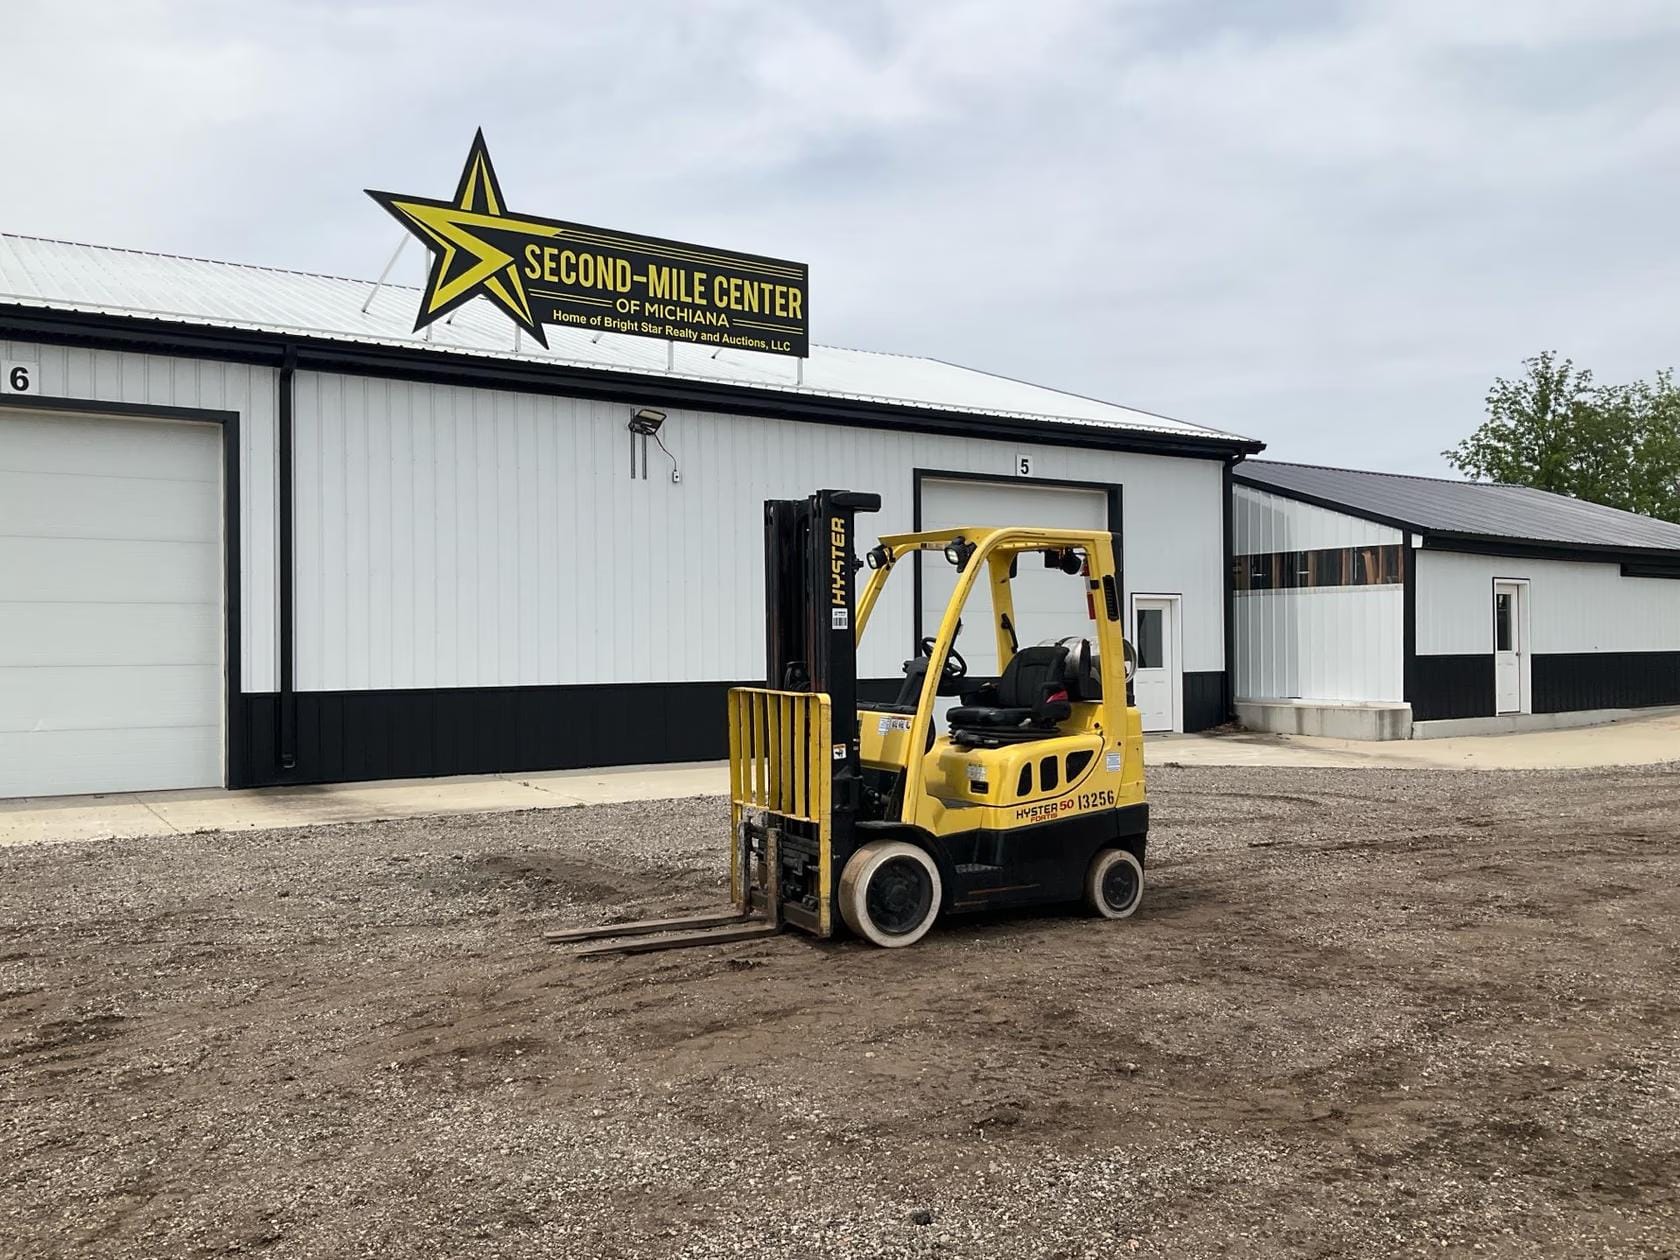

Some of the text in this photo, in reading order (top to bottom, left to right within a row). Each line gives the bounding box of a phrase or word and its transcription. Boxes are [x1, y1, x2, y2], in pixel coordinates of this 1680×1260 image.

[524, 244, 802, 320] SECOND-MILE CENTER
[616, 298, 730, 328] OF MICHIANA
[553, 309, 791, 352] Home of Bright Star Realty and Auctions, LLC
[10, 366, 30, 391] 6
[1020, 458, 1029, 474] 5
[832, 517, 846, 605] HYSTER
[1016, 790, 1115, 819] HYSTER 50 13256
[1030, 813, 1058, 823] FORTIS
